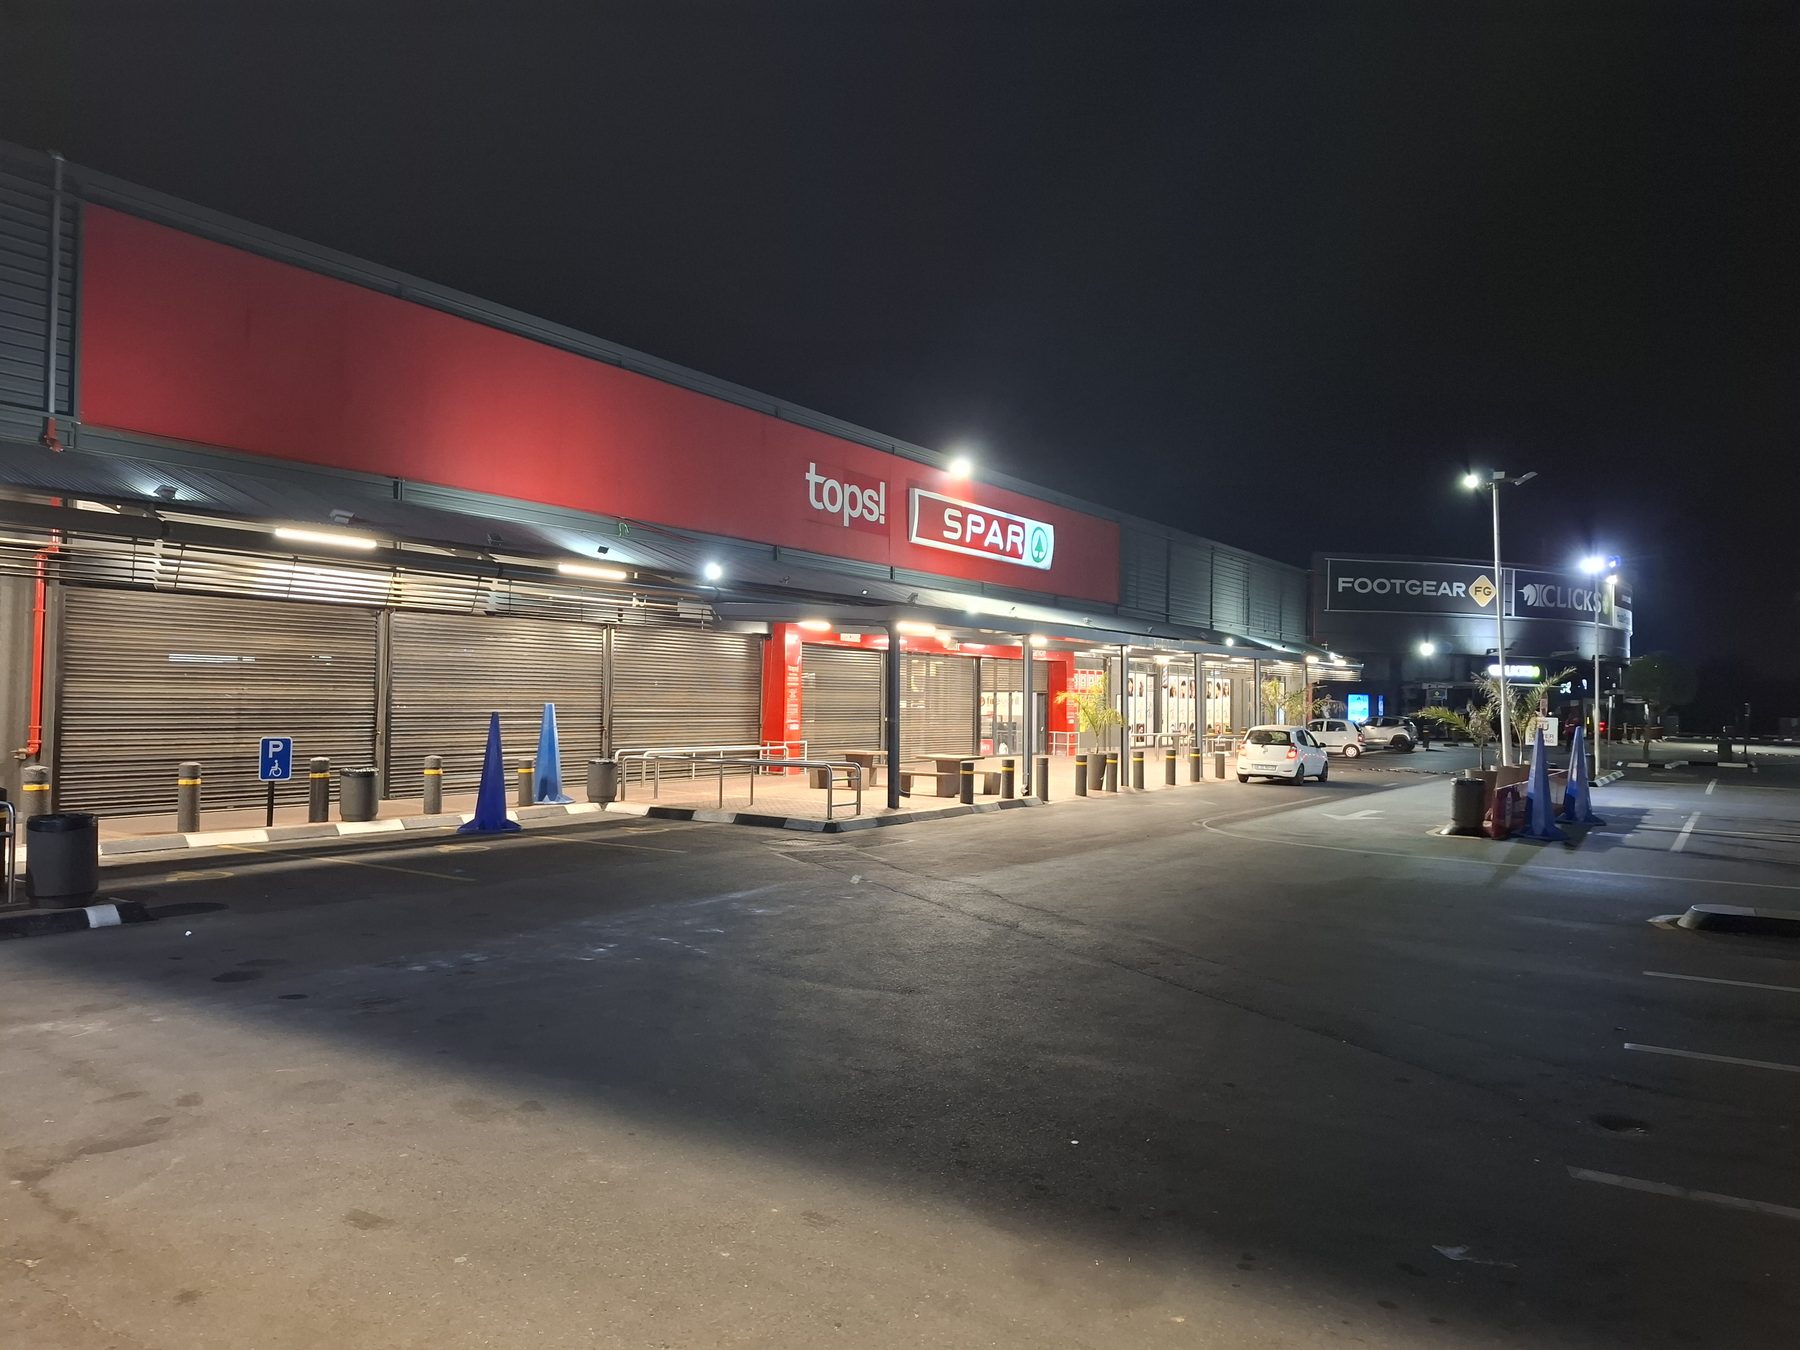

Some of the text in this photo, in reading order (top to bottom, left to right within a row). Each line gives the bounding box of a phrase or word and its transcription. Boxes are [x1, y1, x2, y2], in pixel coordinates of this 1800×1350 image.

[805, 462, 886, 527] tops!
[942, 507, 1024, 555] SPAR
[1337, 577, 1466, 598] FOOTGEAR
[1474, 586, 1492, 597] FG
[1542, 584, 1602, 613] CLICKS
[268, 740, 284, 759] P
